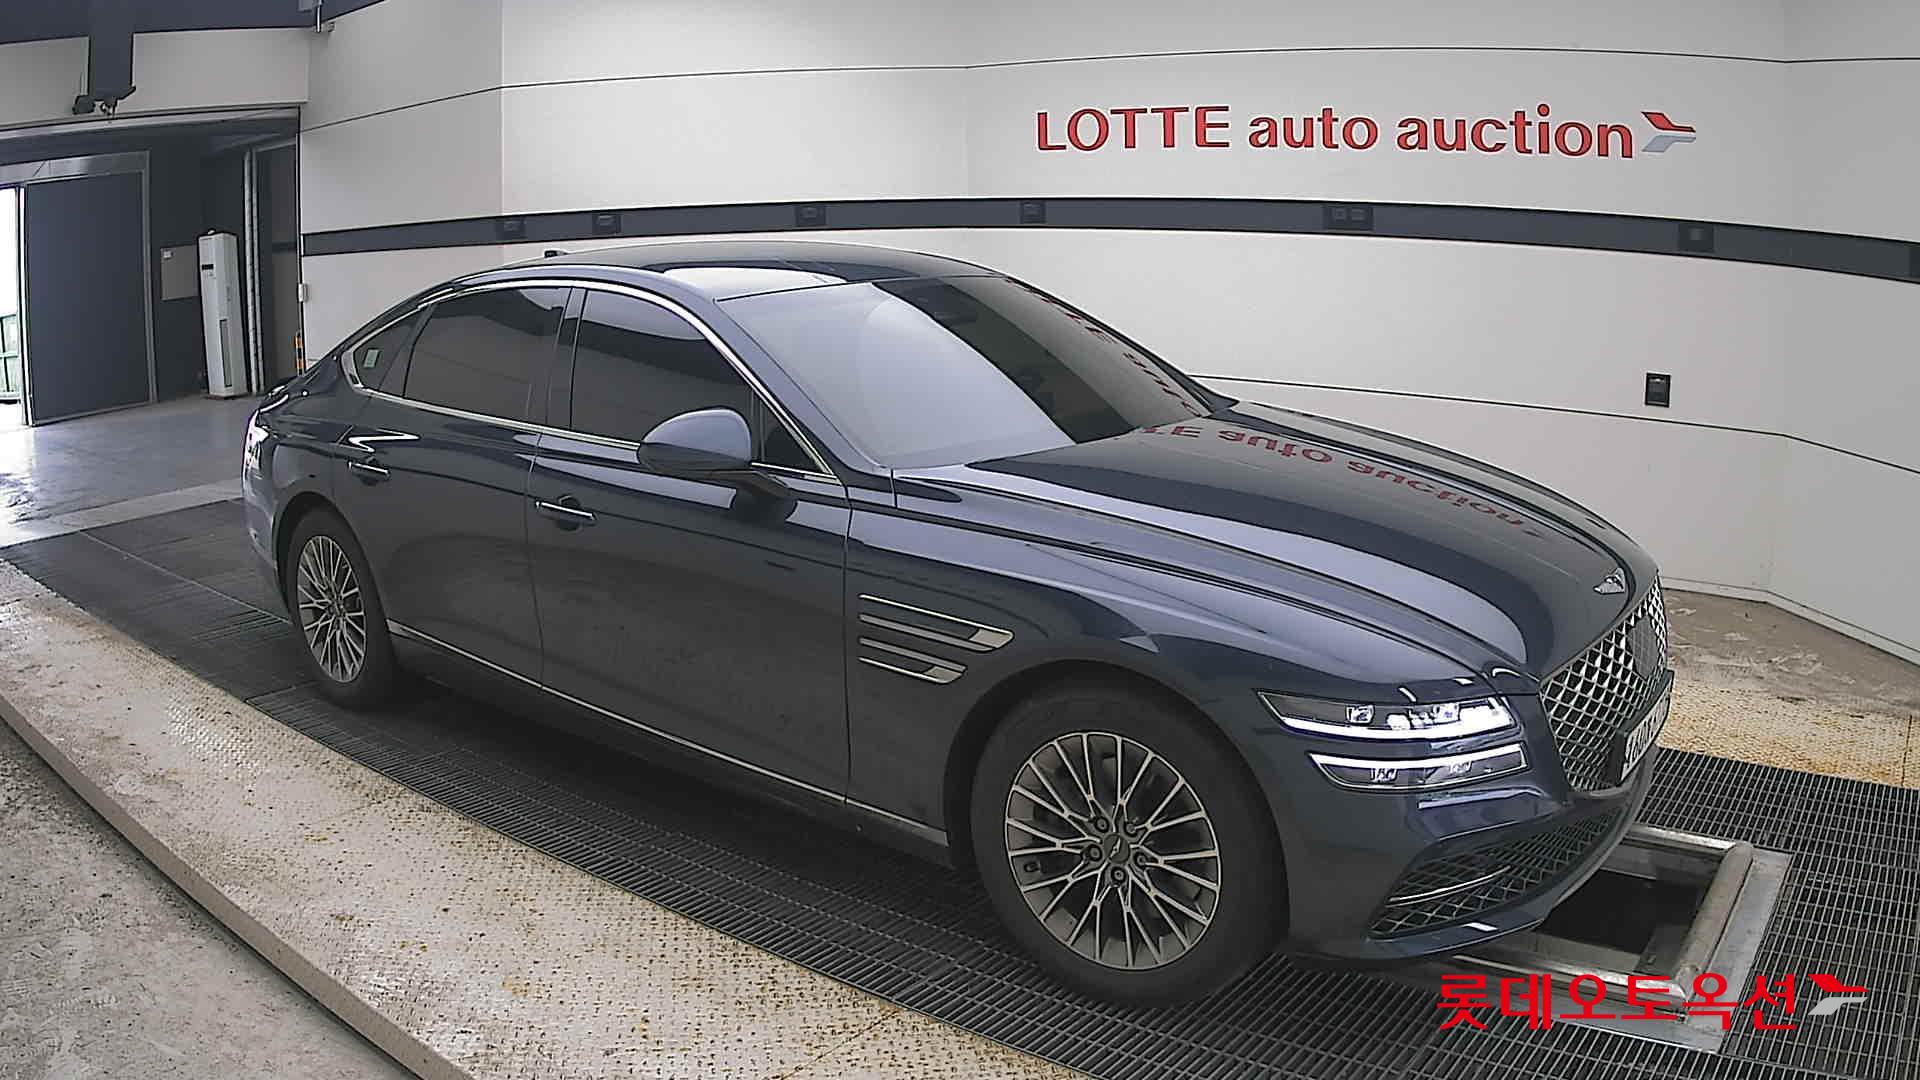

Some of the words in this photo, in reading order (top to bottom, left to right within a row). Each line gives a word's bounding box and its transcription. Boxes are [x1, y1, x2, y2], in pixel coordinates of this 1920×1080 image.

[1036, 104, 1231, 153] LOTTE
[1248, 106, 1379, 151] auto
[1396, 103, 1634, 159] auction
